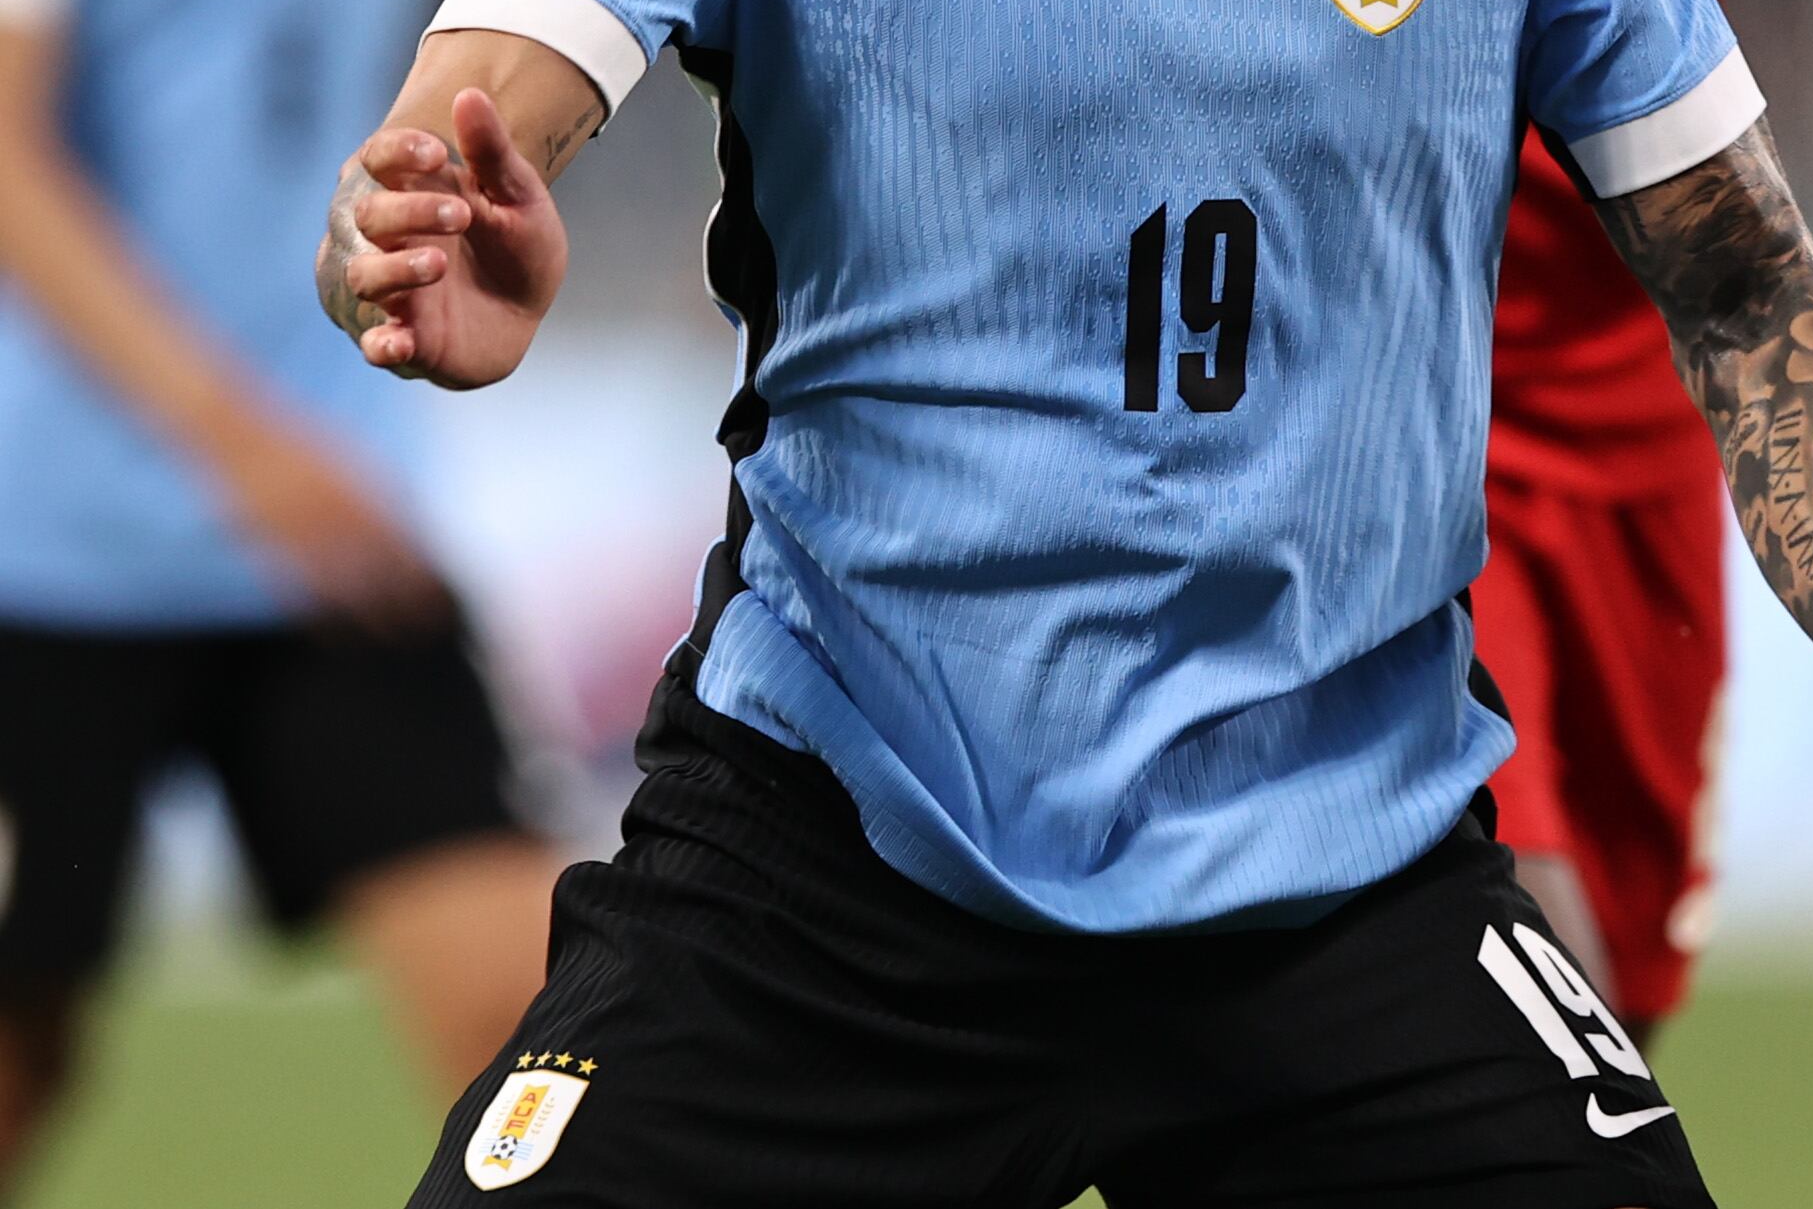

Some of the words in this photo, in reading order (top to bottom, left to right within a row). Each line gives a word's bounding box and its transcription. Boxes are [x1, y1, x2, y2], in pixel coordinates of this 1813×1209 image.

[1124, 199, 1258, 413] 19
[1477, 921, 1652, 1081] 19
[505, 1091, 537, 1132] AUF
